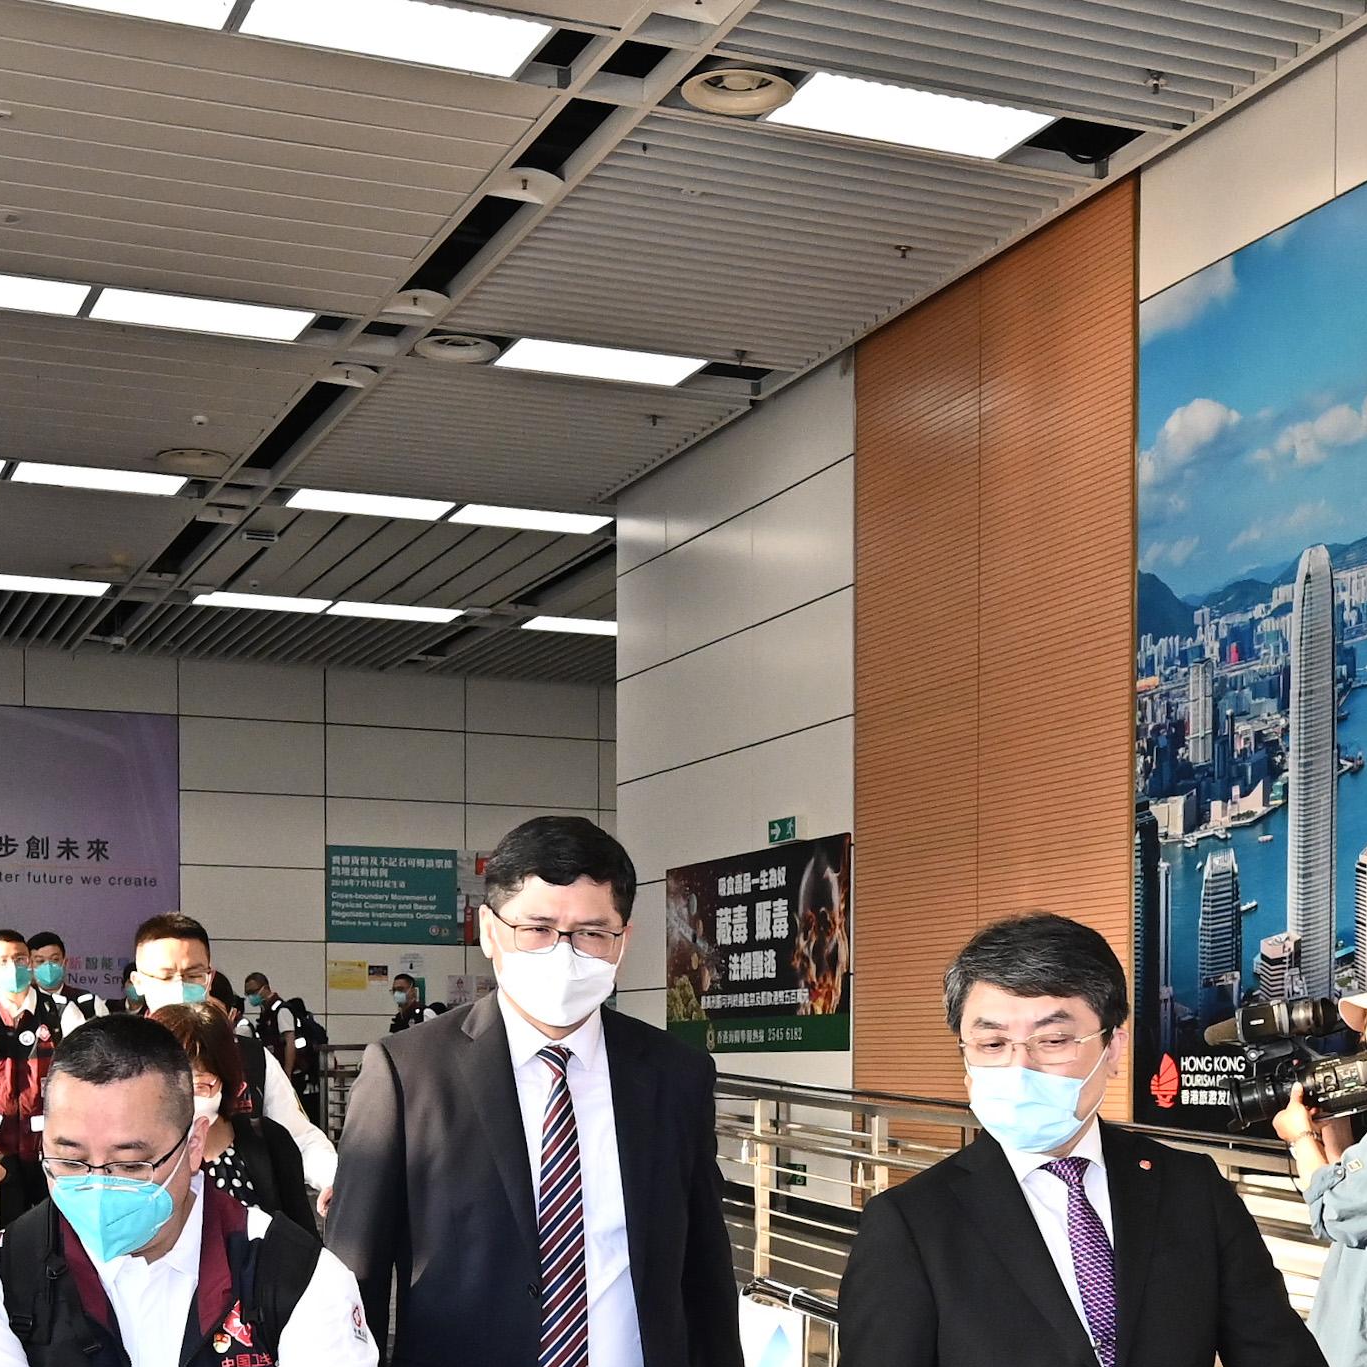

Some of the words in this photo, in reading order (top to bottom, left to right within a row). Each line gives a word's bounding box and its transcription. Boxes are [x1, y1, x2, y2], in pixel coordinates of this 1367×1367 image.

[26, 870, 73, 885] future
[81, 875, 102, 886] we
[108, 874, 158, 888] create
[332, 892, 390, 901] Cross-boundary
[391, 893, 428, 901] Movement
[332, 901, 362, 909] Physical
[364, 902, 397, 910] Currency
[372, 911, 414, 919] Instruments
[755, 897, 789, 941] 販毒
[68, 973, 99, 985] New
[767, 1027, 784, 1042] 2545
[785, 1026, 803, 1041] 6182
[1180, 1056, 1213, 1072] HONG
[1213, 1056, 1246, 1072] KONG
[1181, 1073, 1216, 1087] TOURISM
